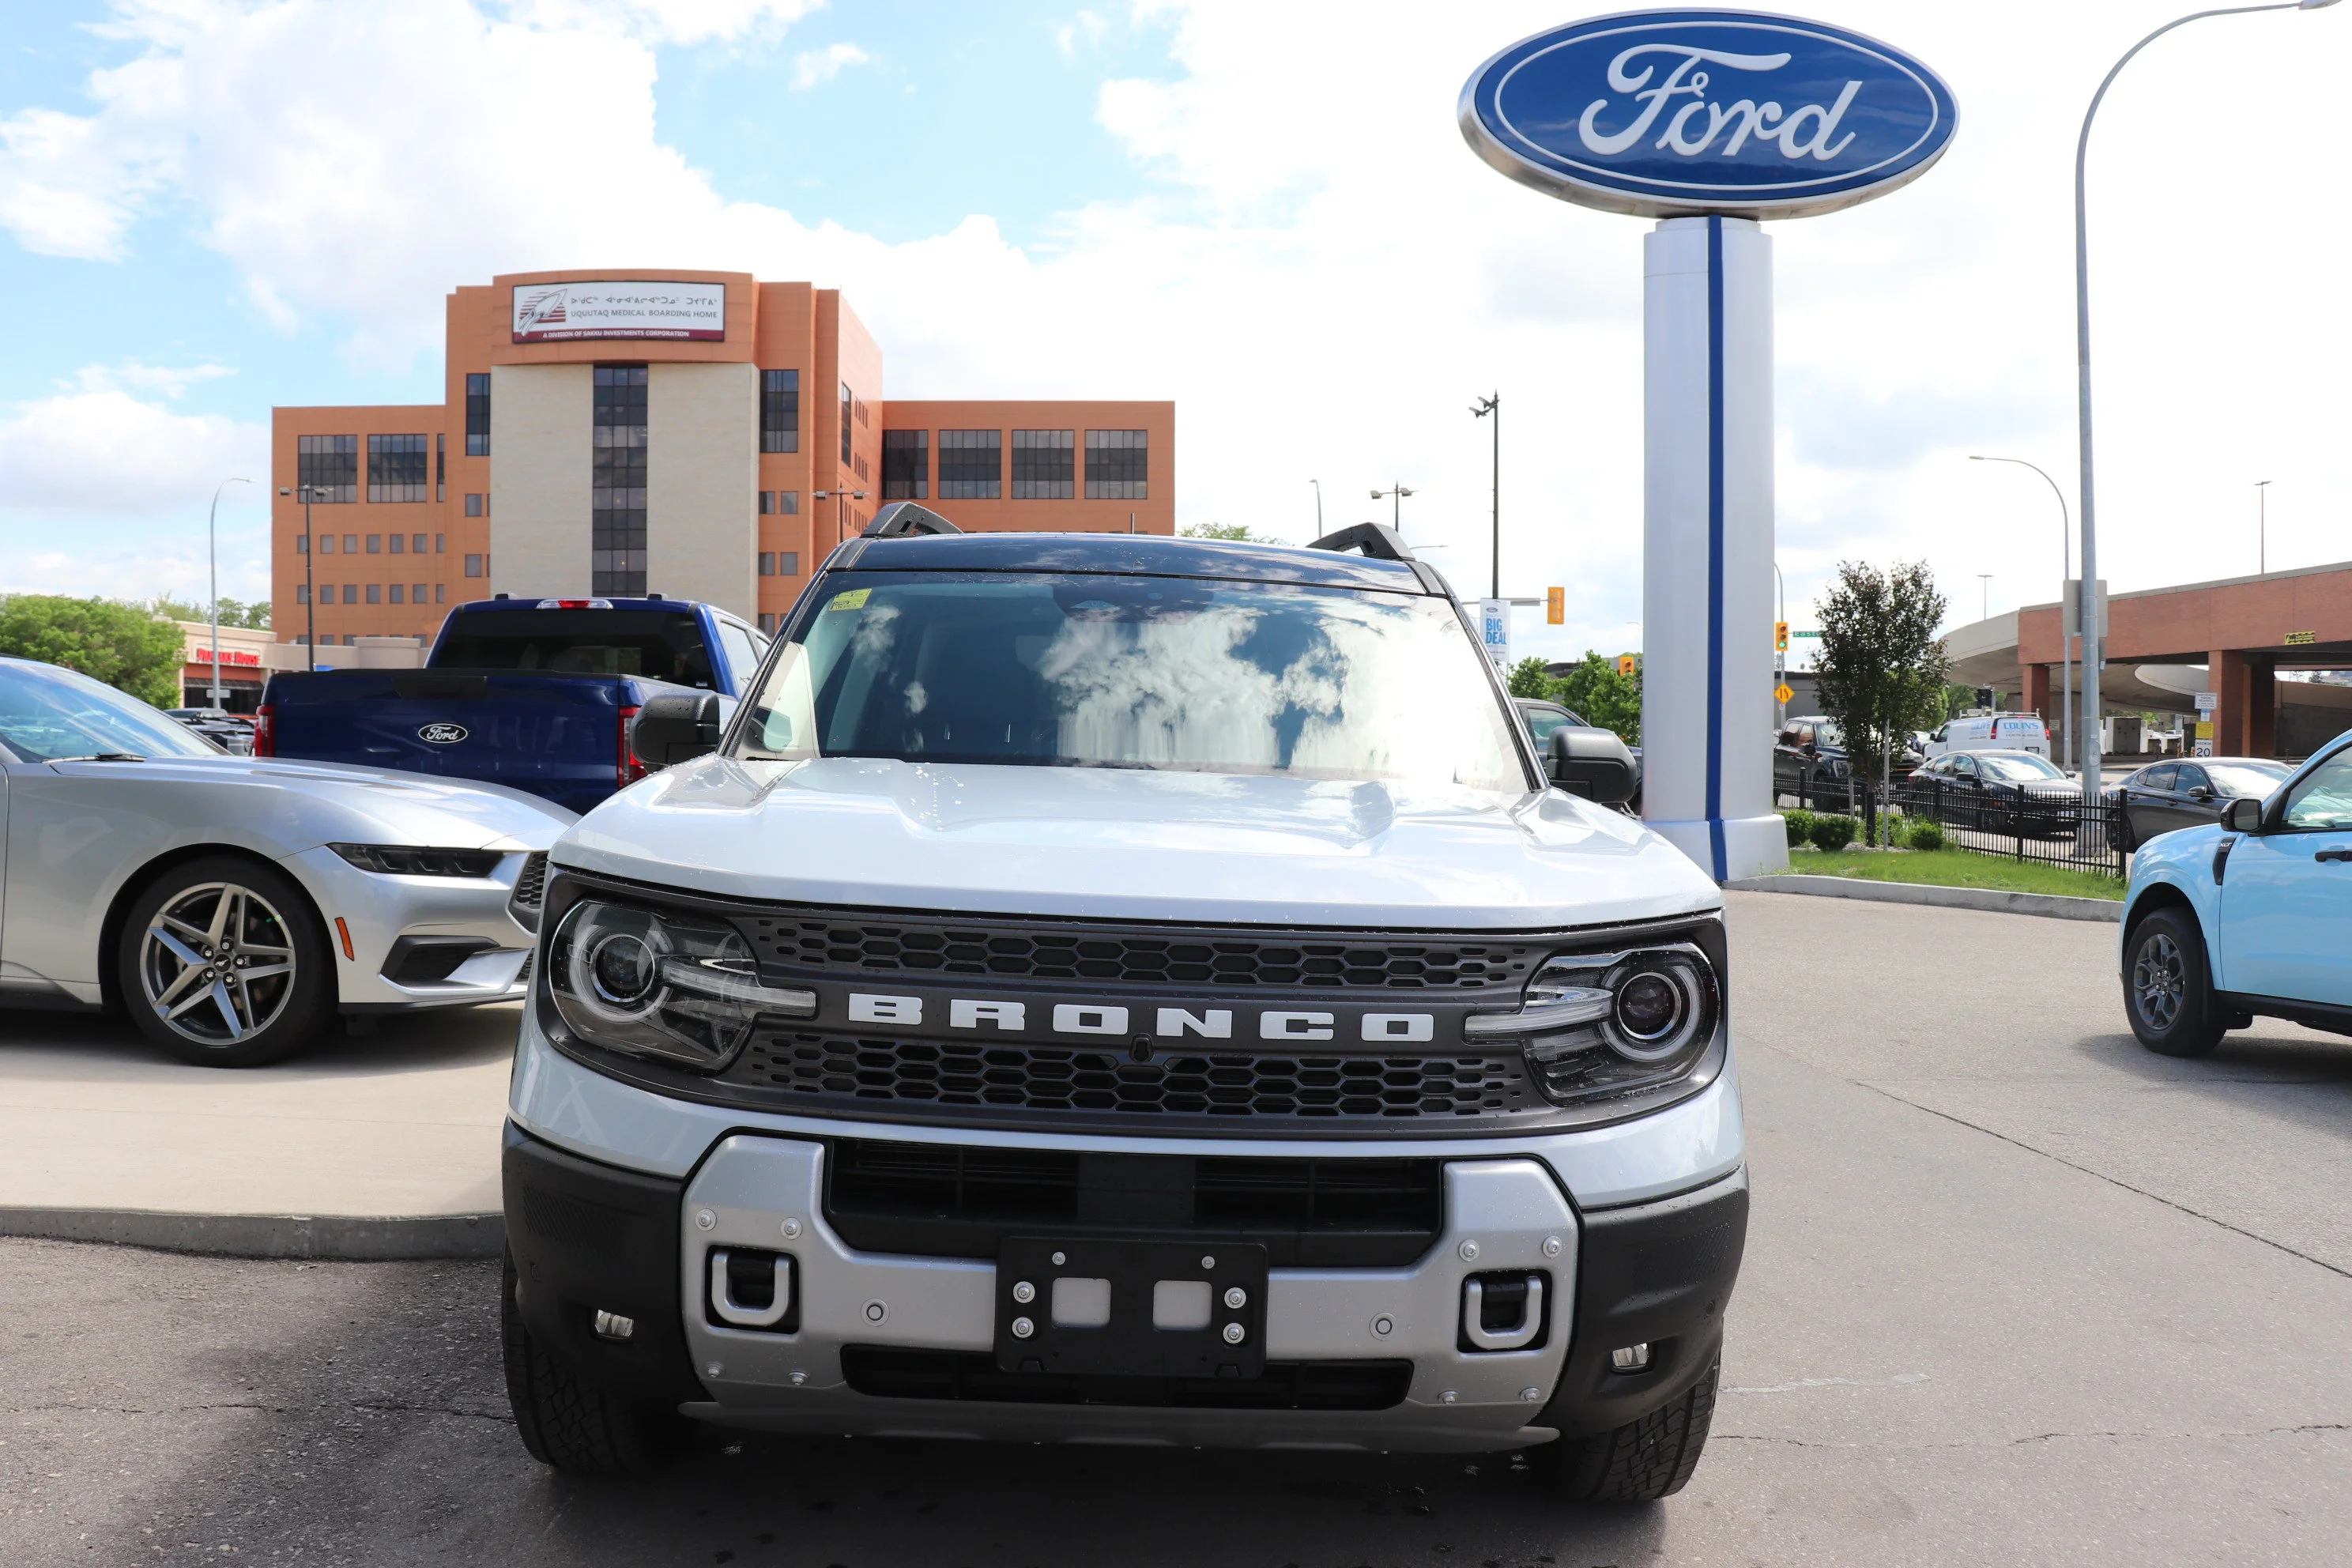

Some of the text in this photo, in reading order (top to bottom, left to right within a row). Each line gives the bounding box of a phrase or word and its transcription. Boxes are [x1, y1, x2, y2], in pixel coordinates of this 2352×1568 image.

[1579, 43, 1862, 160] Ford
[1486, 617, 1502, 631] BIG
[1485, 631, 1506, 645] DEAL
[197, 648, 234, 662] PANAKE
[426, 726, 459, 740] Ford
[2196, 748, 2211, 757] 20
[848, 993, 1434, 1042] BRONCO
